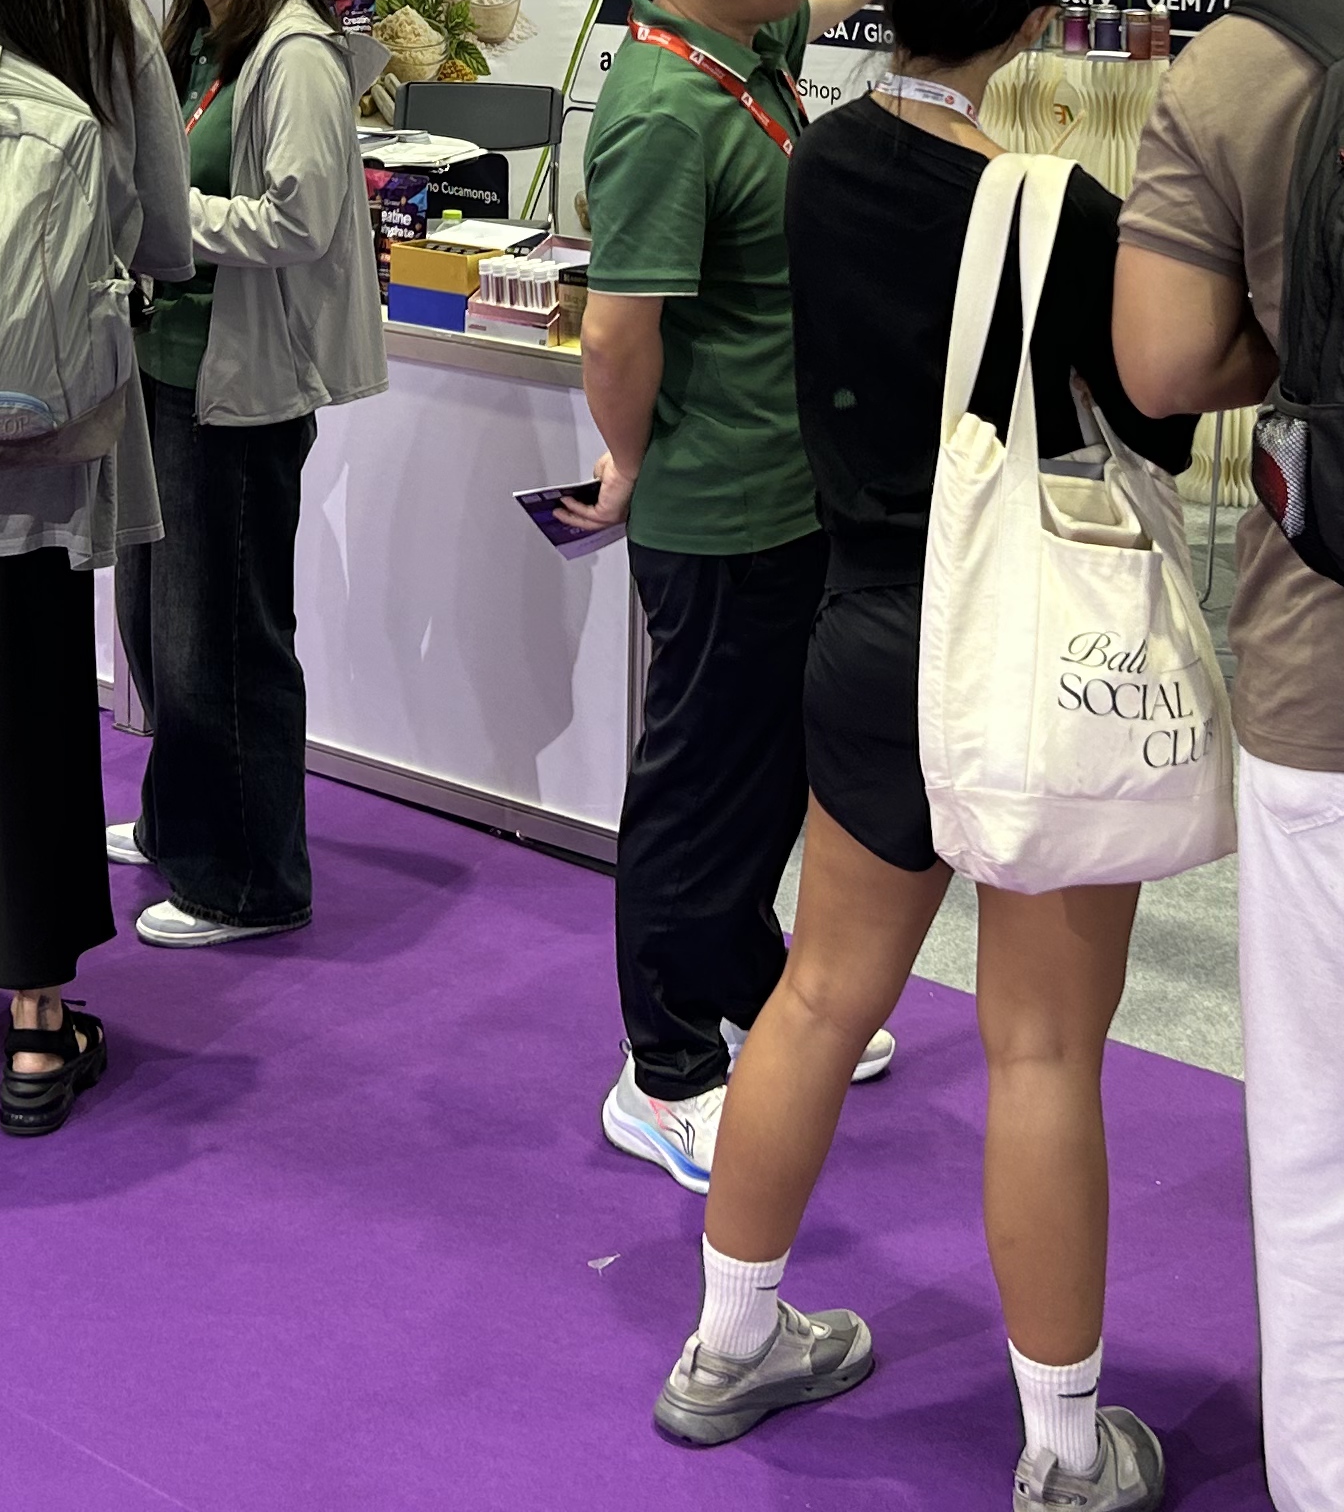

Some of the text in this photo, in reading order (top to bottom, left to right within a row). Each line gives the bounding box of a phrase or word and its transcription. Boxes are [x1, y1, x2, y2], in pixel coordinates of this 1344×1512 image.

[798, 78, 842, 105] Shop
[441, 181, 501, 204] Cucamonga,
[1059, 630, 1148, 674] Bali
[1057, 672, 1194, 721] SOCIAL
